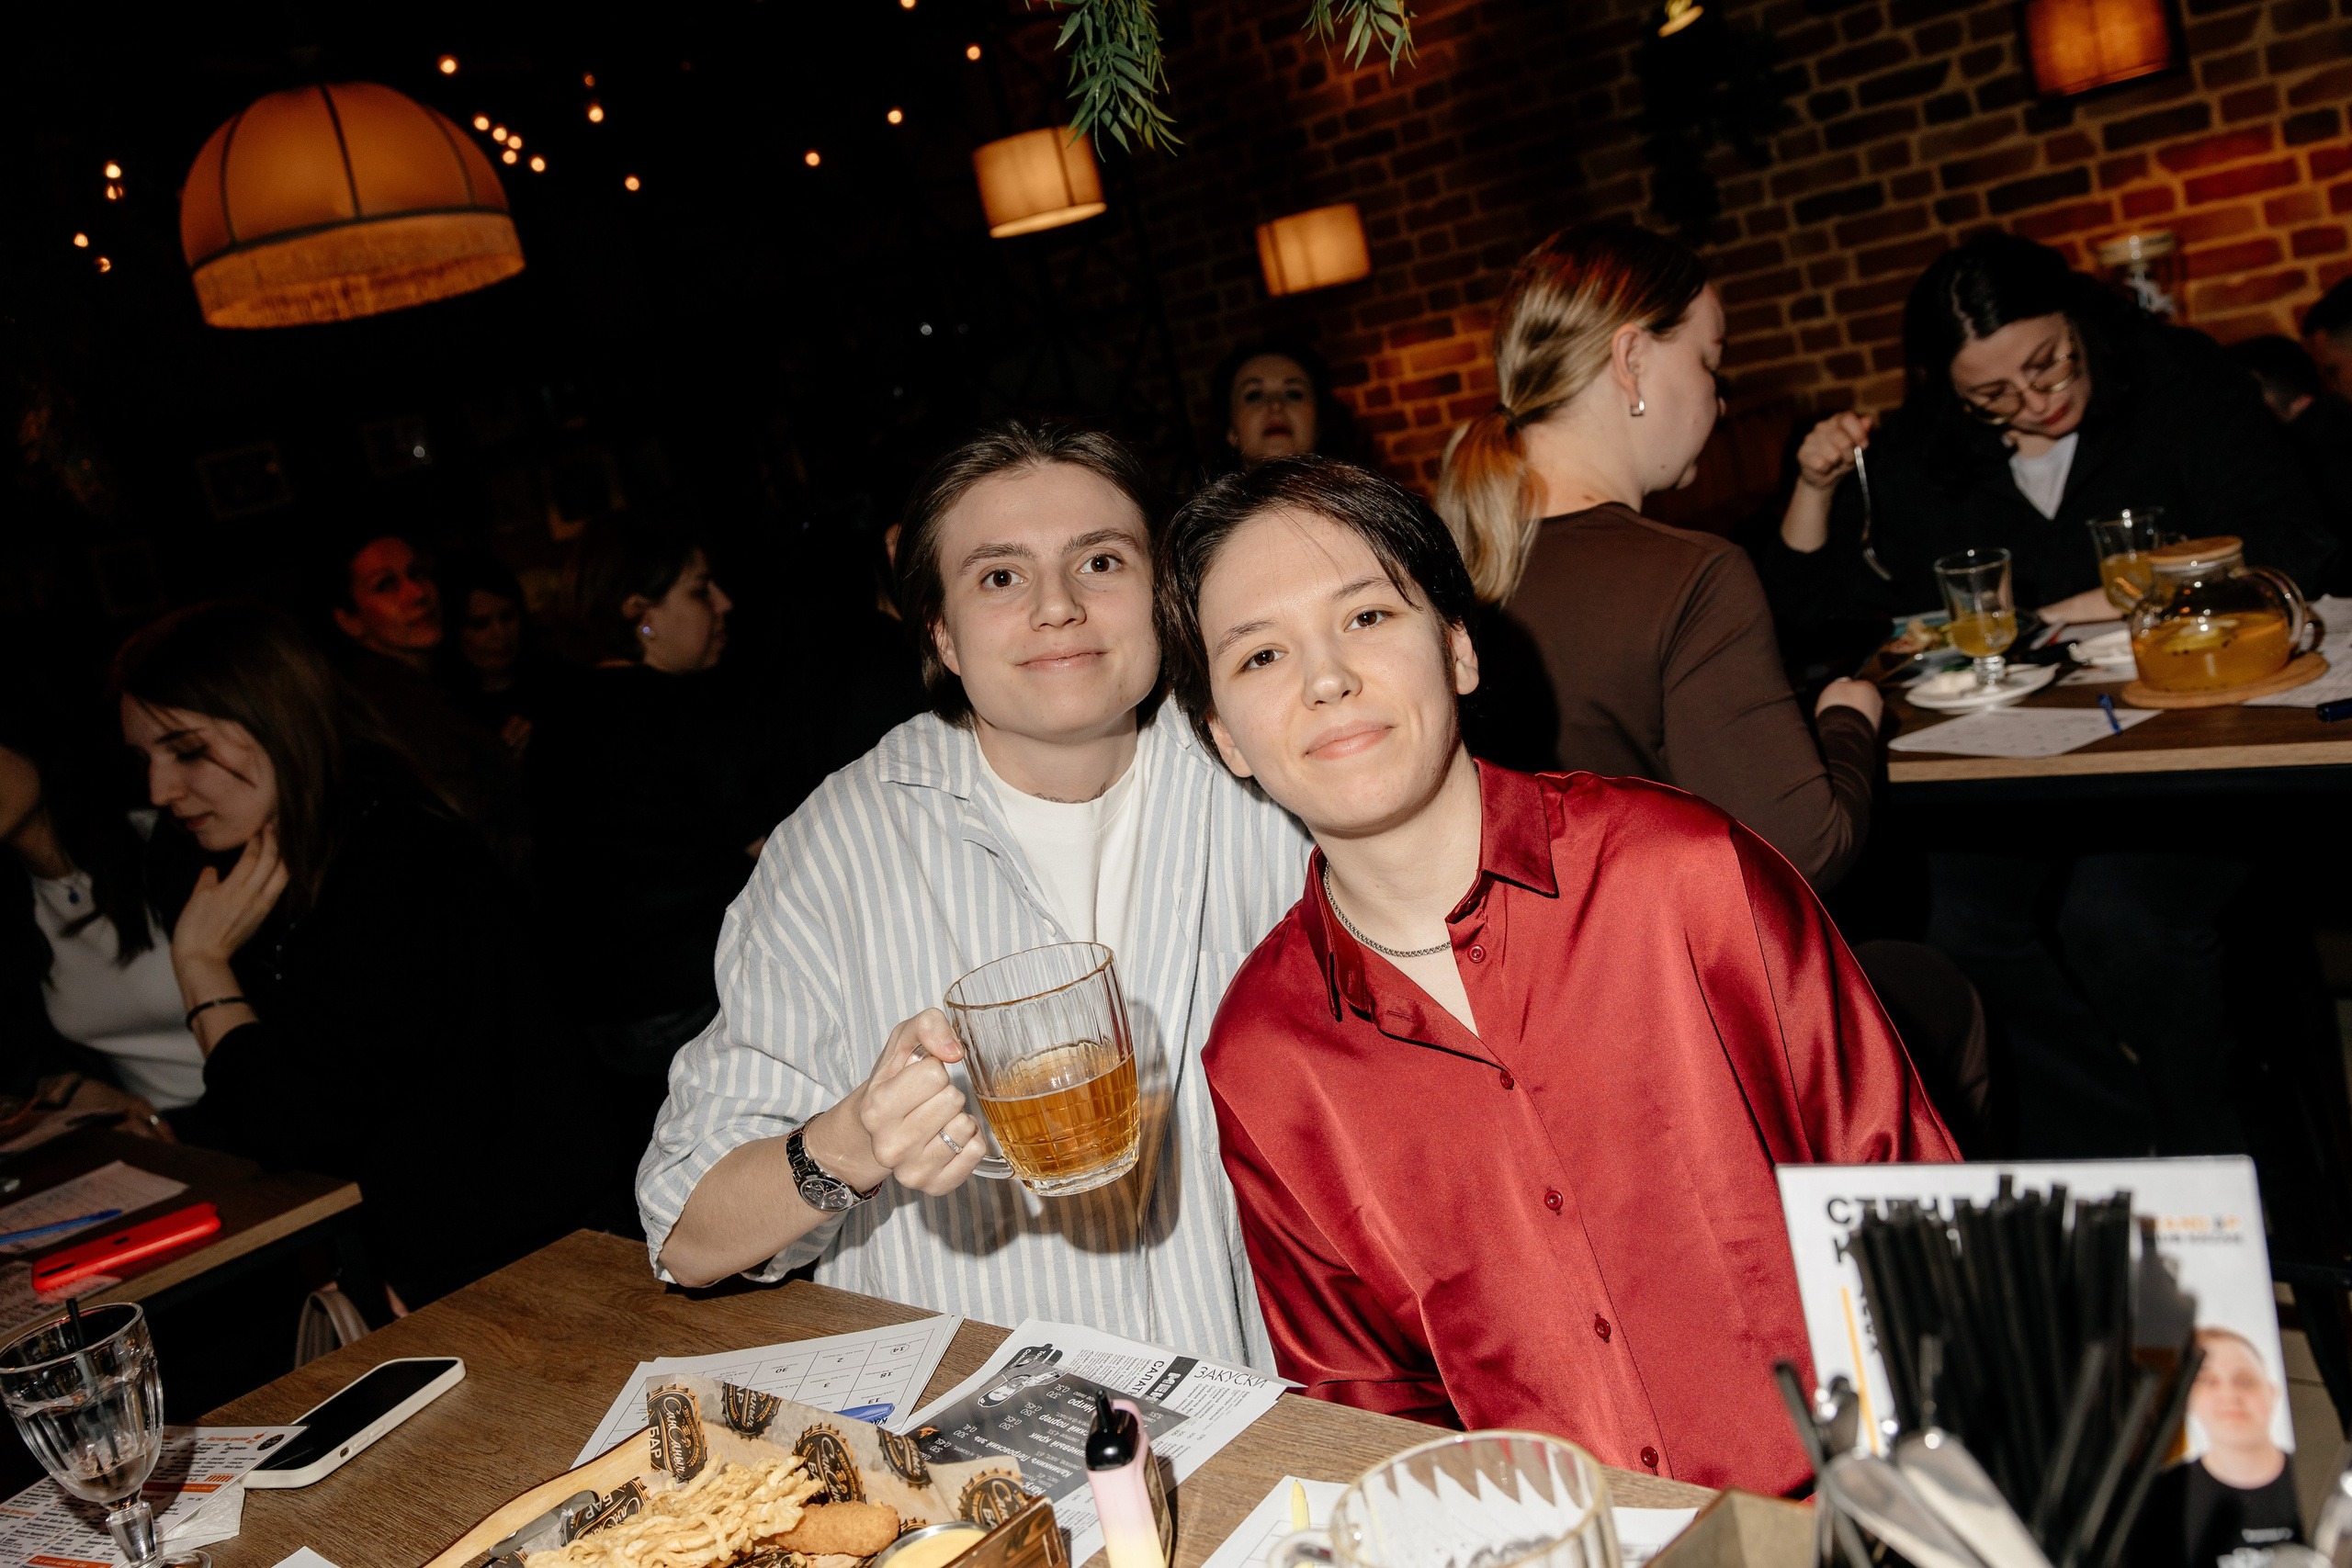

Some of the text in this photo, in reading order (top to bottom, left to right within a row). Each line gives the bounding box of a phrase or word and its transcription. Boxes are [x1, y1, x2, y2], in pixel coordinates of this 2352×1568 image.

[892, 1346, 905, 1354] 14
[1193, 1366, 1269, 1389] ЗАКУСКИ
[1046, 1391, 1061, 1399] 370
[1067, 1398, 1097, 1414] Нитро
[1020, 1408, 1035, 1416] 350
[998, 1422, 1014, 1431] 350
[1038, 1414, 1070, 1428] портер
[953, 1429, 968, 1438] 300
[1028, 1432, 1052, 1444] крик
[648, 1425, 663, 1460] БАР
[974, 1435, 988, 1445] эль
[985, 1440, 1031, 1462] Петровский
